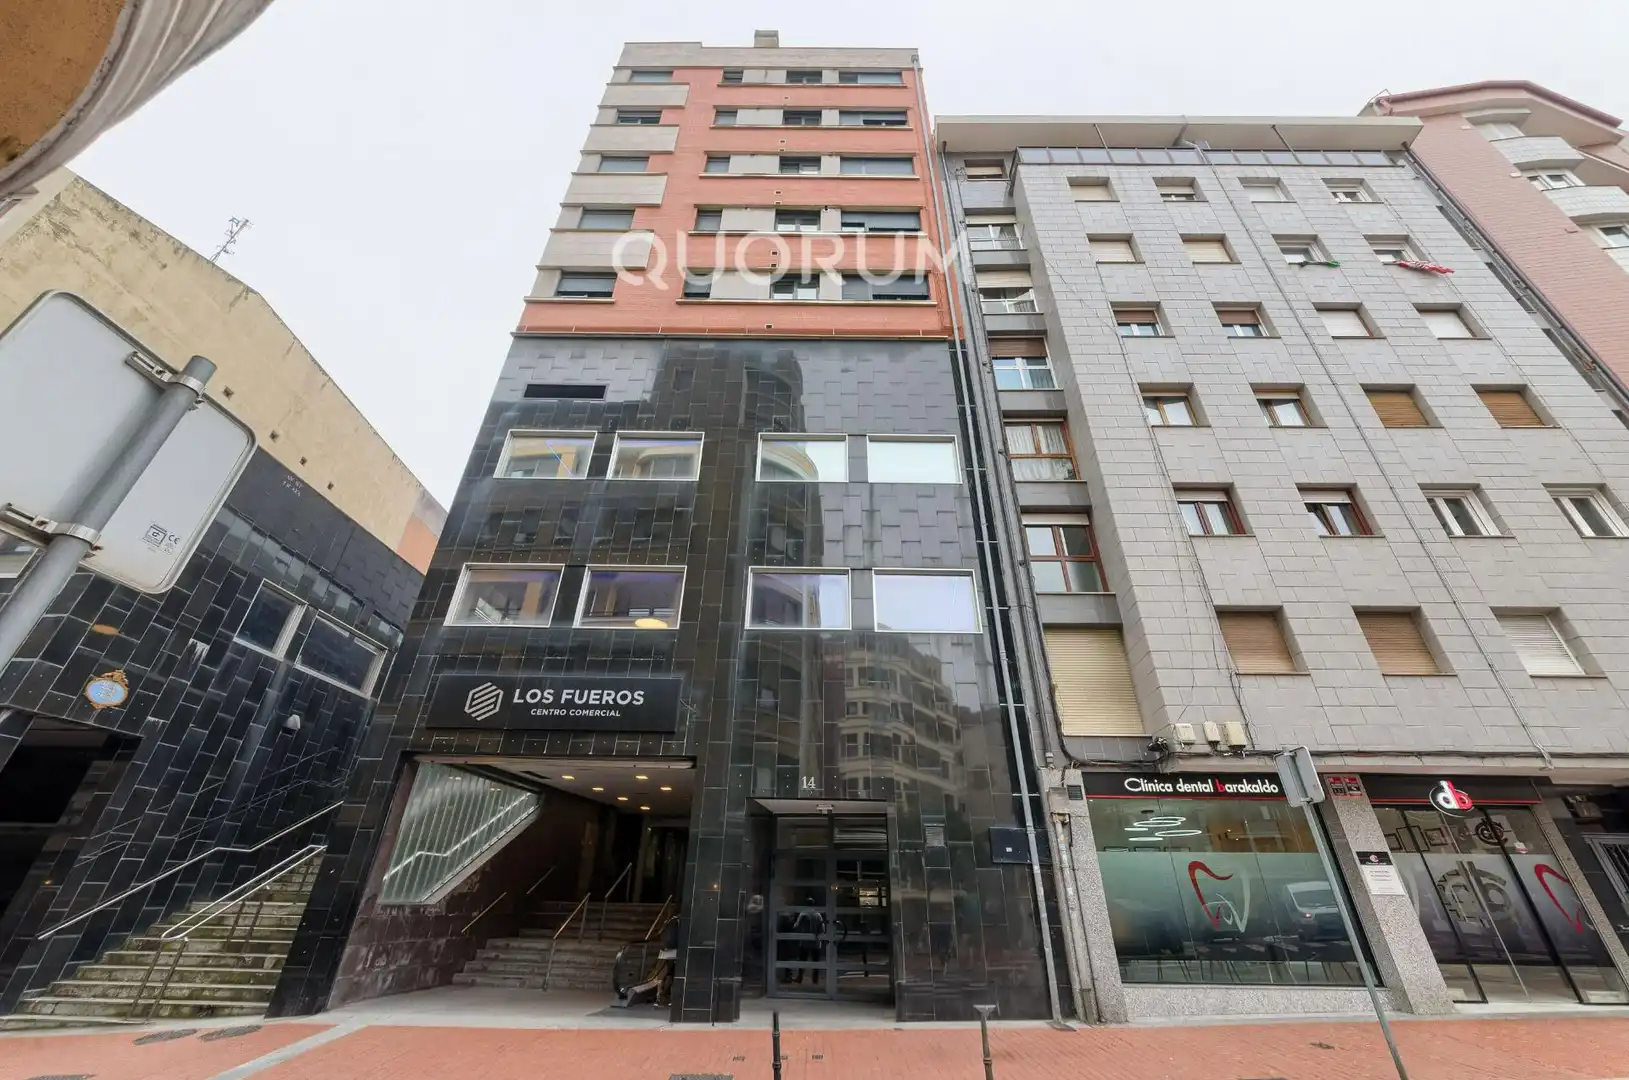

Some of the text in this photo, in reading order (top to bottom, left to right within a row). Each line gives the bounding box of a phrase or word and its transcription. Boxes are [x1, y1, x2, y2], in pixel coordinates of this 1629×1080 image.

[513, 688, 645, 705] LOS FUEROS
[530, 708, 621, 717] CENTRO COMERCIAL
[801, 776, 816, 789] 14
[1124, 777, 1279, 794] Clínica dental barakaldo
